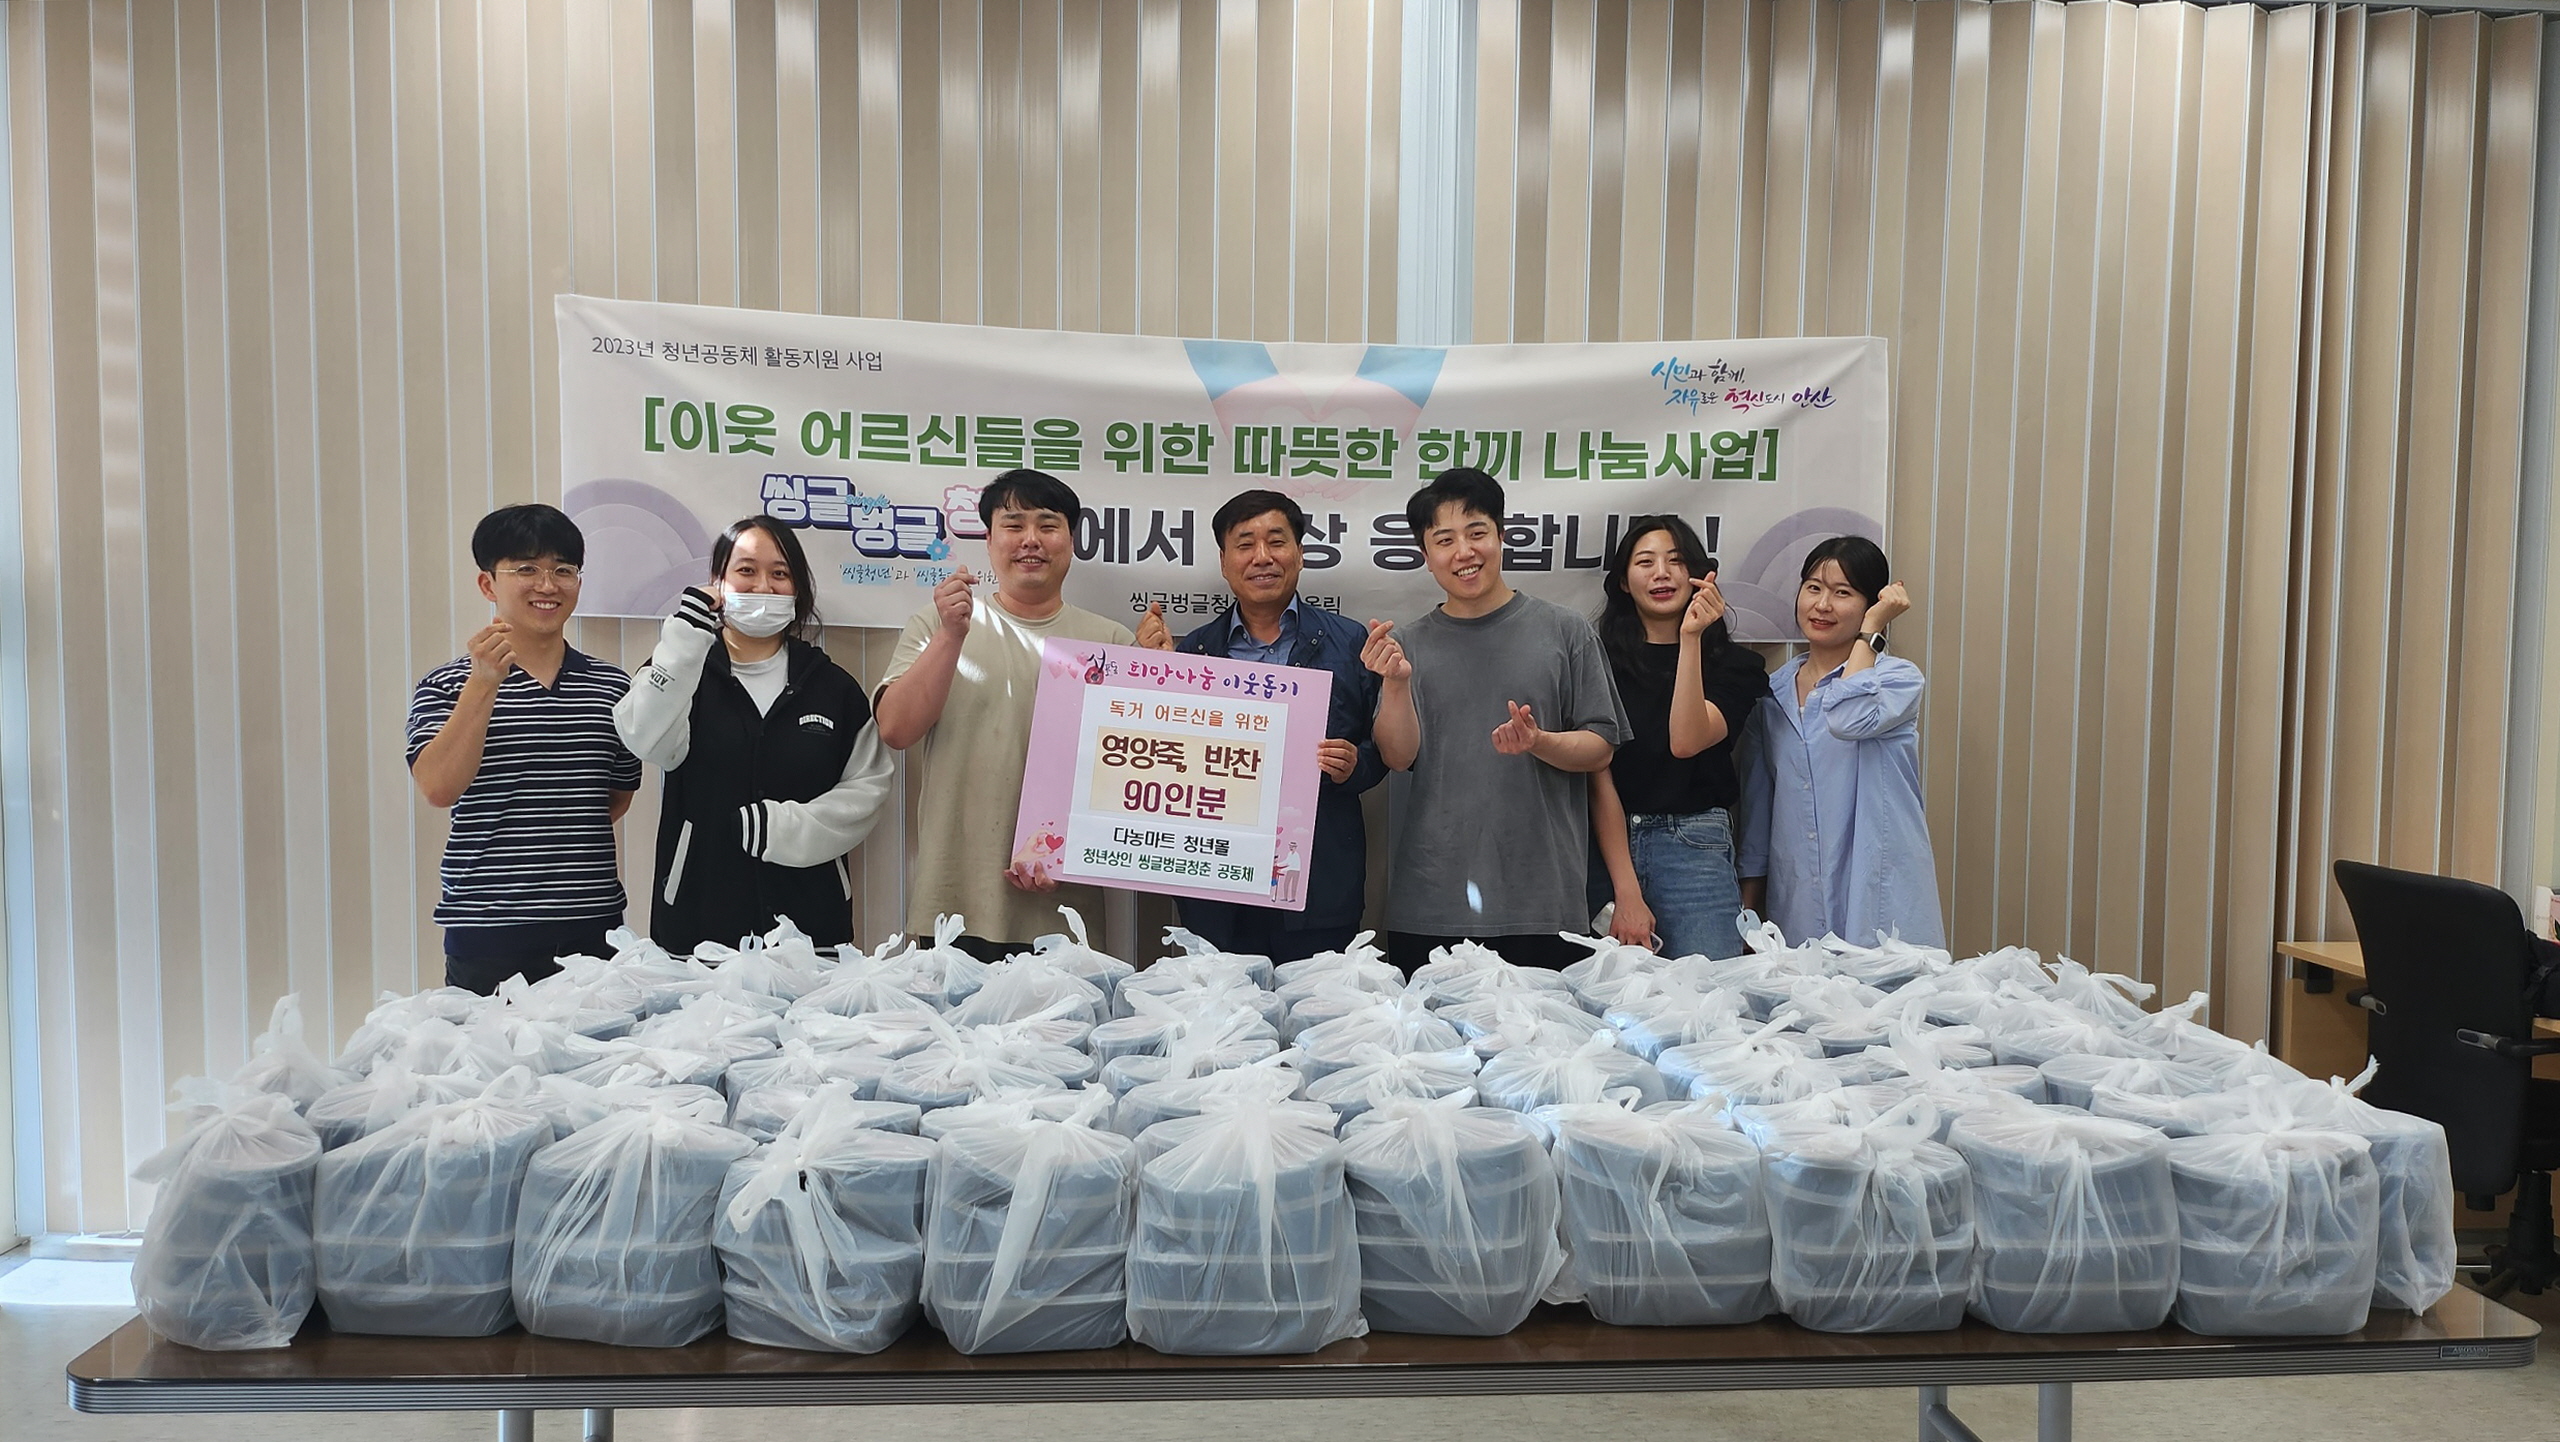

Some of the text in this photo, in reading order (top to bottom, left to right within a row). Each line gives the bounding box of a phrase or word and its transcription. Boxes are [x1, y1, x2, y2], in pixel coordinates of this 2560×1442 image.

[592, 336, 883, 371] 2023년 청년공동체 활동지원 사업
[1651, 356, 1707, 390] 시민과
[1665, 387, 1836, 416] 자유로운 혁신도시 안산
[800, 411, 1082, 471] 어르신들을
[1104, 422, 1214, 474] 위한
[1233, 425, 1399, 479] 따뜻한
[1417, 429, 1522, 481] 한끼
[1302, 513, 1347, 570] 상
[1129, 592, 1237, 614] 씽글벙글청
[1127, 660, 1216, 691] 희망나눔
[1223, 672, 1299, 699] 이웃돕기
[1109, 700, 1269, 732] 독거 어르신을 위한
[1204, 744, 1262, 780] 반찬
[1123, 779, 1227, 820] 90인분
[1113, 827, 1230, 856] 다농마트 청년몰
[1083, 848, 1255, 882] 청년상인 씽글벙글청춘 공동체
